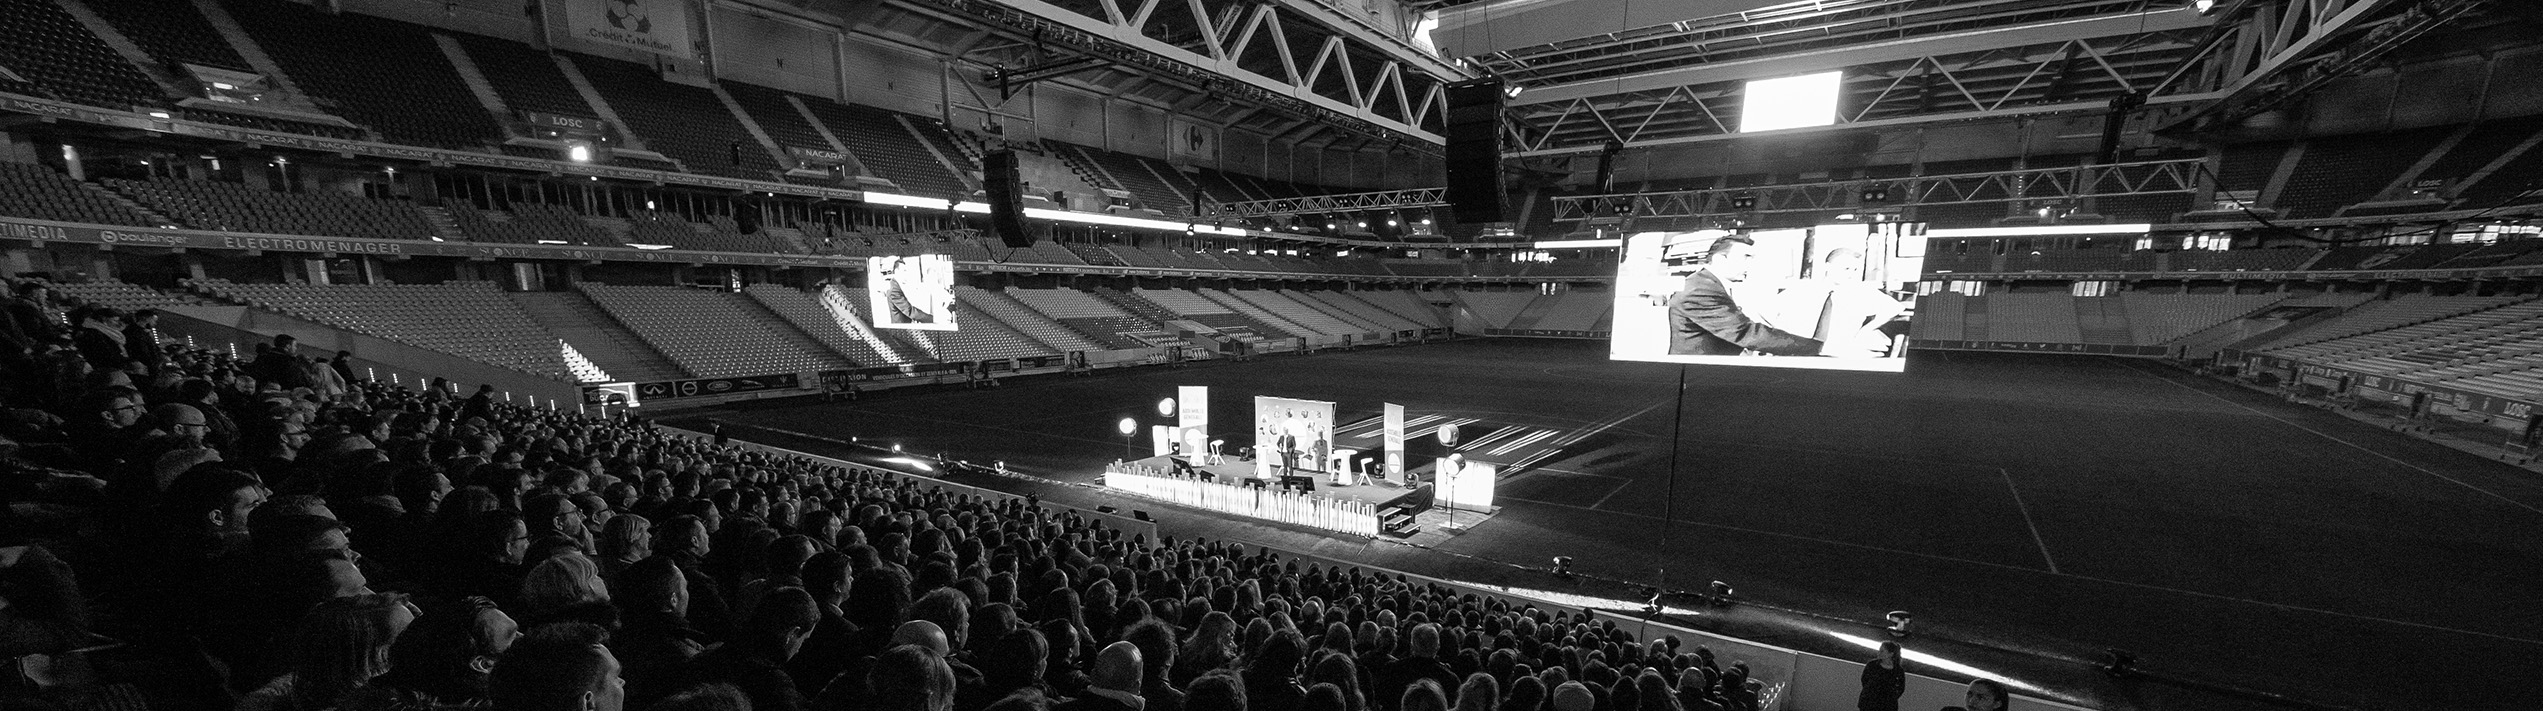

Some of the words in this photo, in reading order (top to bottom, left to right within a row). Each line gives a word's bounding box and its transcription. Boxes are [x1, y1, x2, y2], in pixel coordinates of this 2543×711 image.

[589, 27, 625, 44] Crédit
[636, 37, 673, 52] Mutuel
[14, 101, 72, 116] NACARAT
[552, 116, 583, 128] LOSC
[247, 133, 299, 145] NACARAT
[319, 142, 367, 152] NACARAT
[387, 148, 433, 158] NACARAT
[805, 149, 847, 161] NACARAT
[452, 154, 496, 164] NACARAT
[512, 160, 552, 170] NACARAT
[567, 165, 606, 175] NACARAT
[619, 169, 654, 179] NACARAT
[667, 175, 700, 184] NACARAT
[119, 232, 189, 246] boulanger
[225, 236, 402, 254] ELECTROMENAGER
